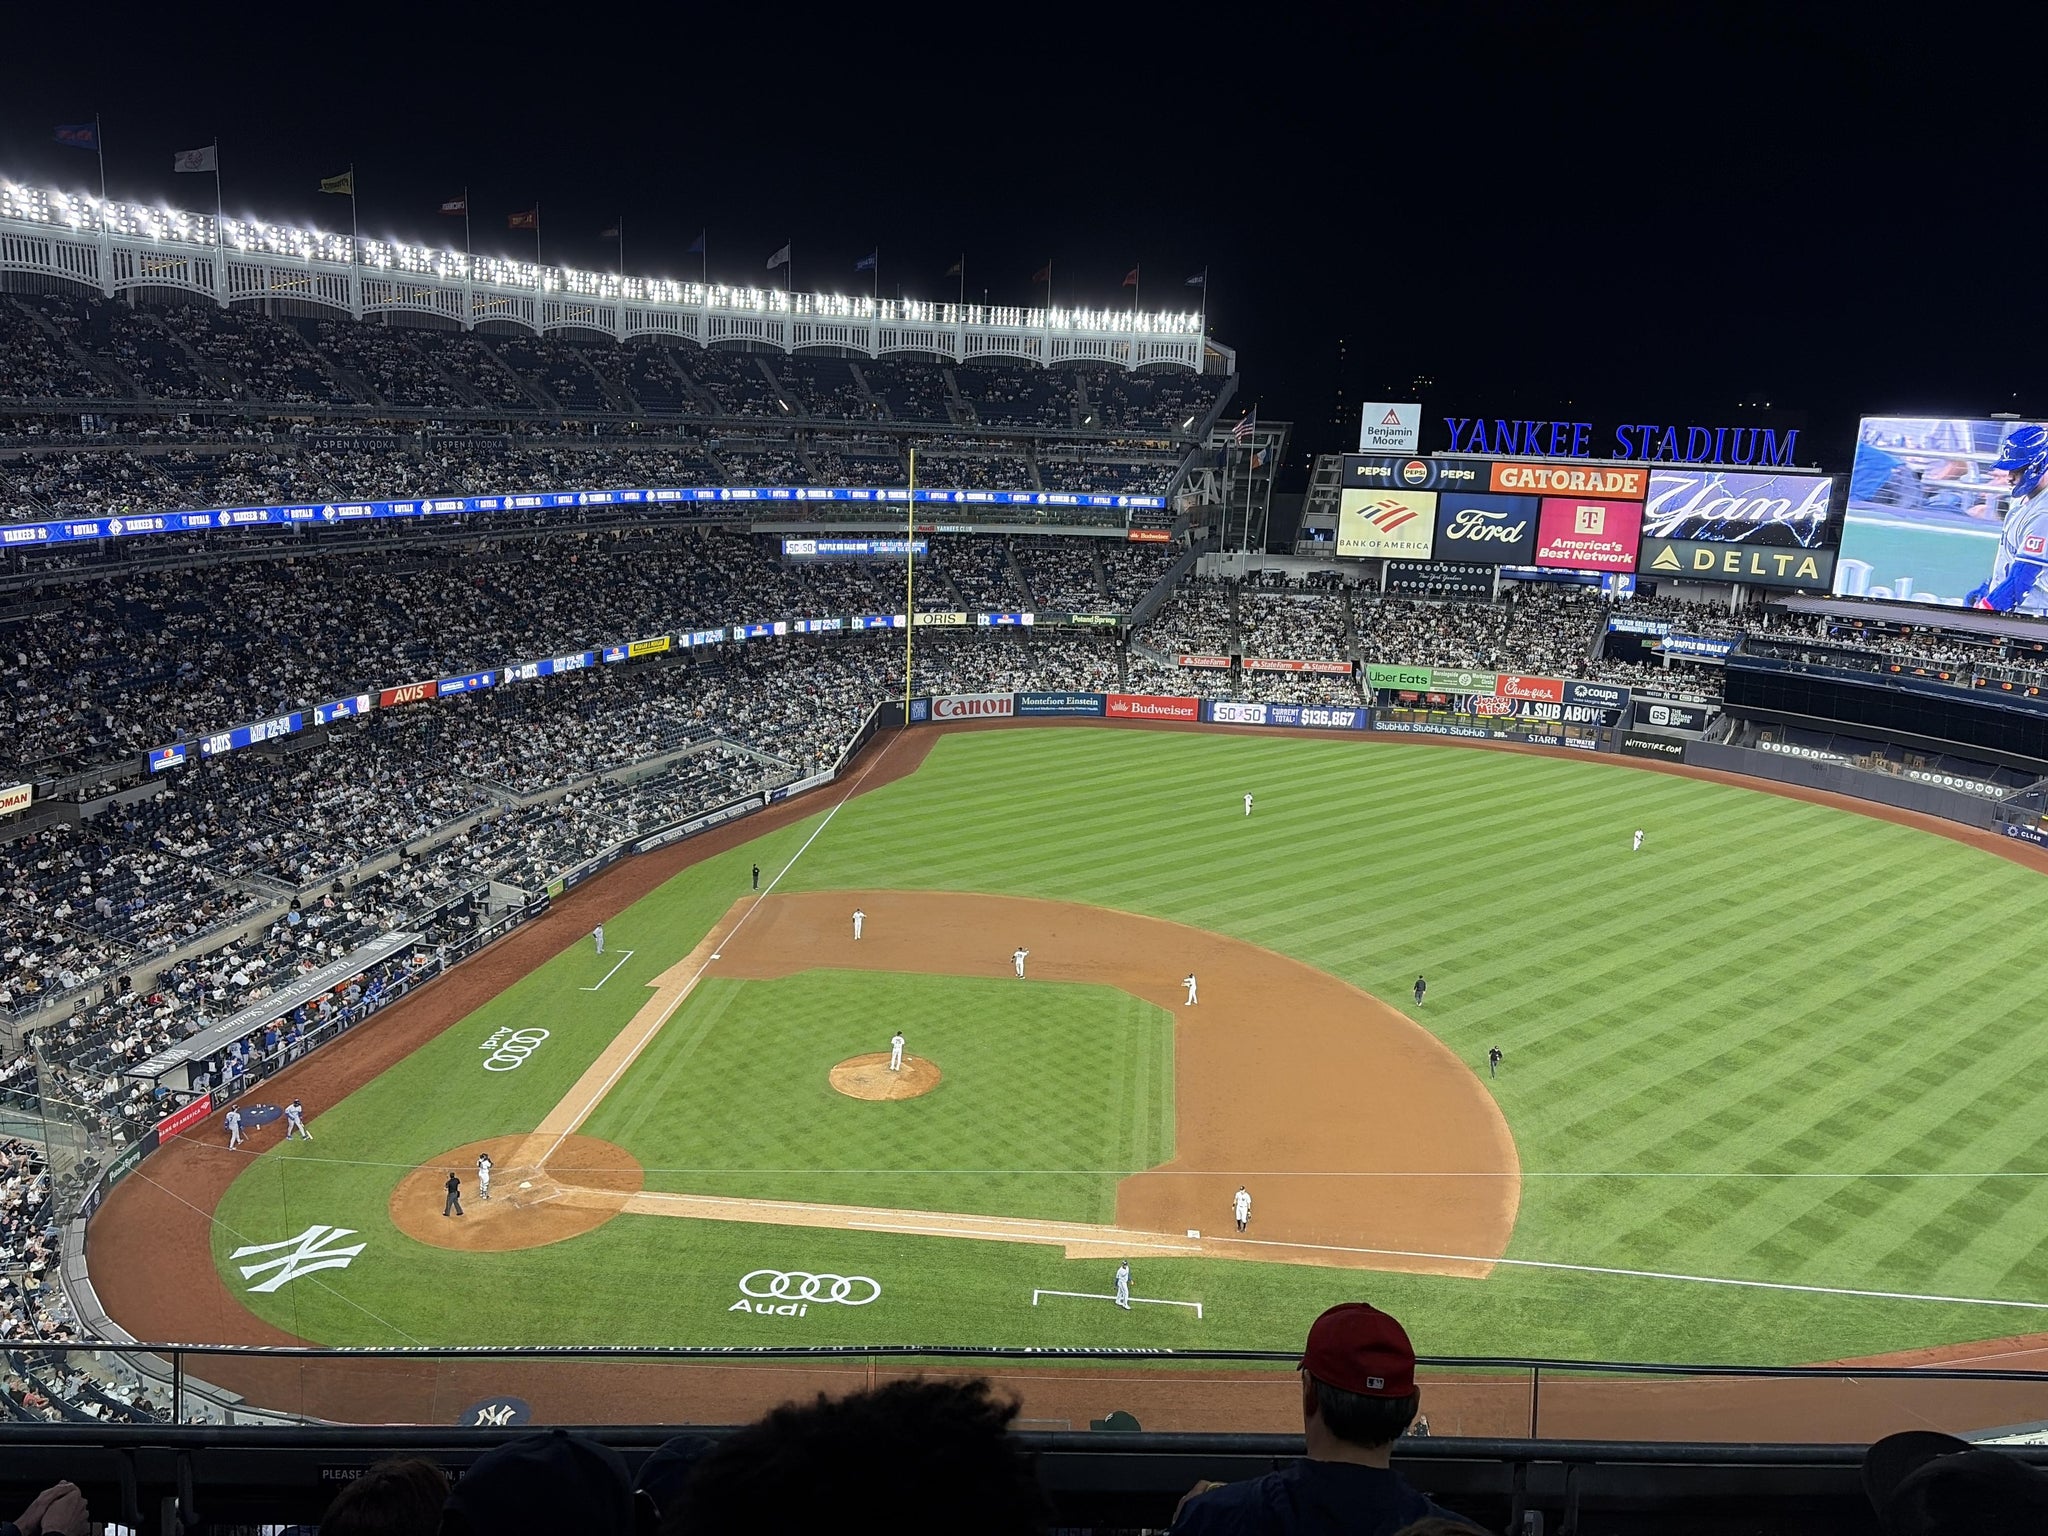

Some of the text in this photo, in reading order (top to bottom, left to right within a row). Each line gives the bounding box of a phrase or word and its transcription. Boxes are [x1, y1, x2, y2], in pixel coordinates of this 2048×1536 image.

[1367, 426, 1413, 438] Benjamin
[315, 440, 396, 450] ASPEN VODKA
[436, 440, 503, 449] ASPEN VODKA
[1372, 436, 1404, 446] Moore
[1443, 417, 1800, 467] YANKEE STADIUM
[1357, 466, 1391, 477] PEPSI
[1405, 468, 1426, 477] PEPSI
[1440, 470, 1475, 481] PEPSI
[1500, 467, 1640, 494] GATORADE
[73, 523, 98, 536] ROYALS
[126, 519, 153, 531] YANKEES
[1446, 509, 1527, 544] Ford
[4, 528, 35, 542] YANKEES
[1339, 540, 1429, 550] BANK OF AMERICA
[1551, 538, 1623, 552] America's
[1539, 547, 1633, 564] Best Network
[1693, 549, 1819, 580] DELTA
[923, 613, 957, 624] ORIS
[1072, 615, 1116, 625] Poland Spring
[1674, 640, 1695, 649] RAFFLE
[1696, 642, 1705, 651] ON
[1370, 671, 1397, 682] Uber
[1399, 673, 1428, 685] Eats
[394, 685, 424, 704] AVIS
[1588, 688, 1618, 701] coupa
[933, 698, 1012, 716] Canon
[1021, 697, 1099, 706] Montefiore Einstein
[1131, 702, 1193, 716] Budweiser
[1219, 707, 1260, 722] 50 50
[1272, 708, 1299, 717] CURRENT
[1522, 702, 1607, 724] A SUB ABOVE
[1652, 710, 1666, 720] GS
[1301, 708, 1355, 728] $136,867
[1376, 722, 1410, 732] StubHub
[1412, 723, 1447, 735] StubHub
[1450, 725, 1485, 738] StubHub
[211, 734, 231, 755] RAYS
[1528, 734, 1558, 745] STARR
[1565, 737, 1596, 746] CUTWATER
[1625, 738, 1683, 756] NITTOTIRE.COM
[2020, 831, 2042, 842] CLEAR
[478, 1026, 513, 1050] Audi
[179, 1109, 201, 1125] AMERICA
[728, 1299, 808, 1317] Audi
[322, 1469, 361, 1480] PLEASE
